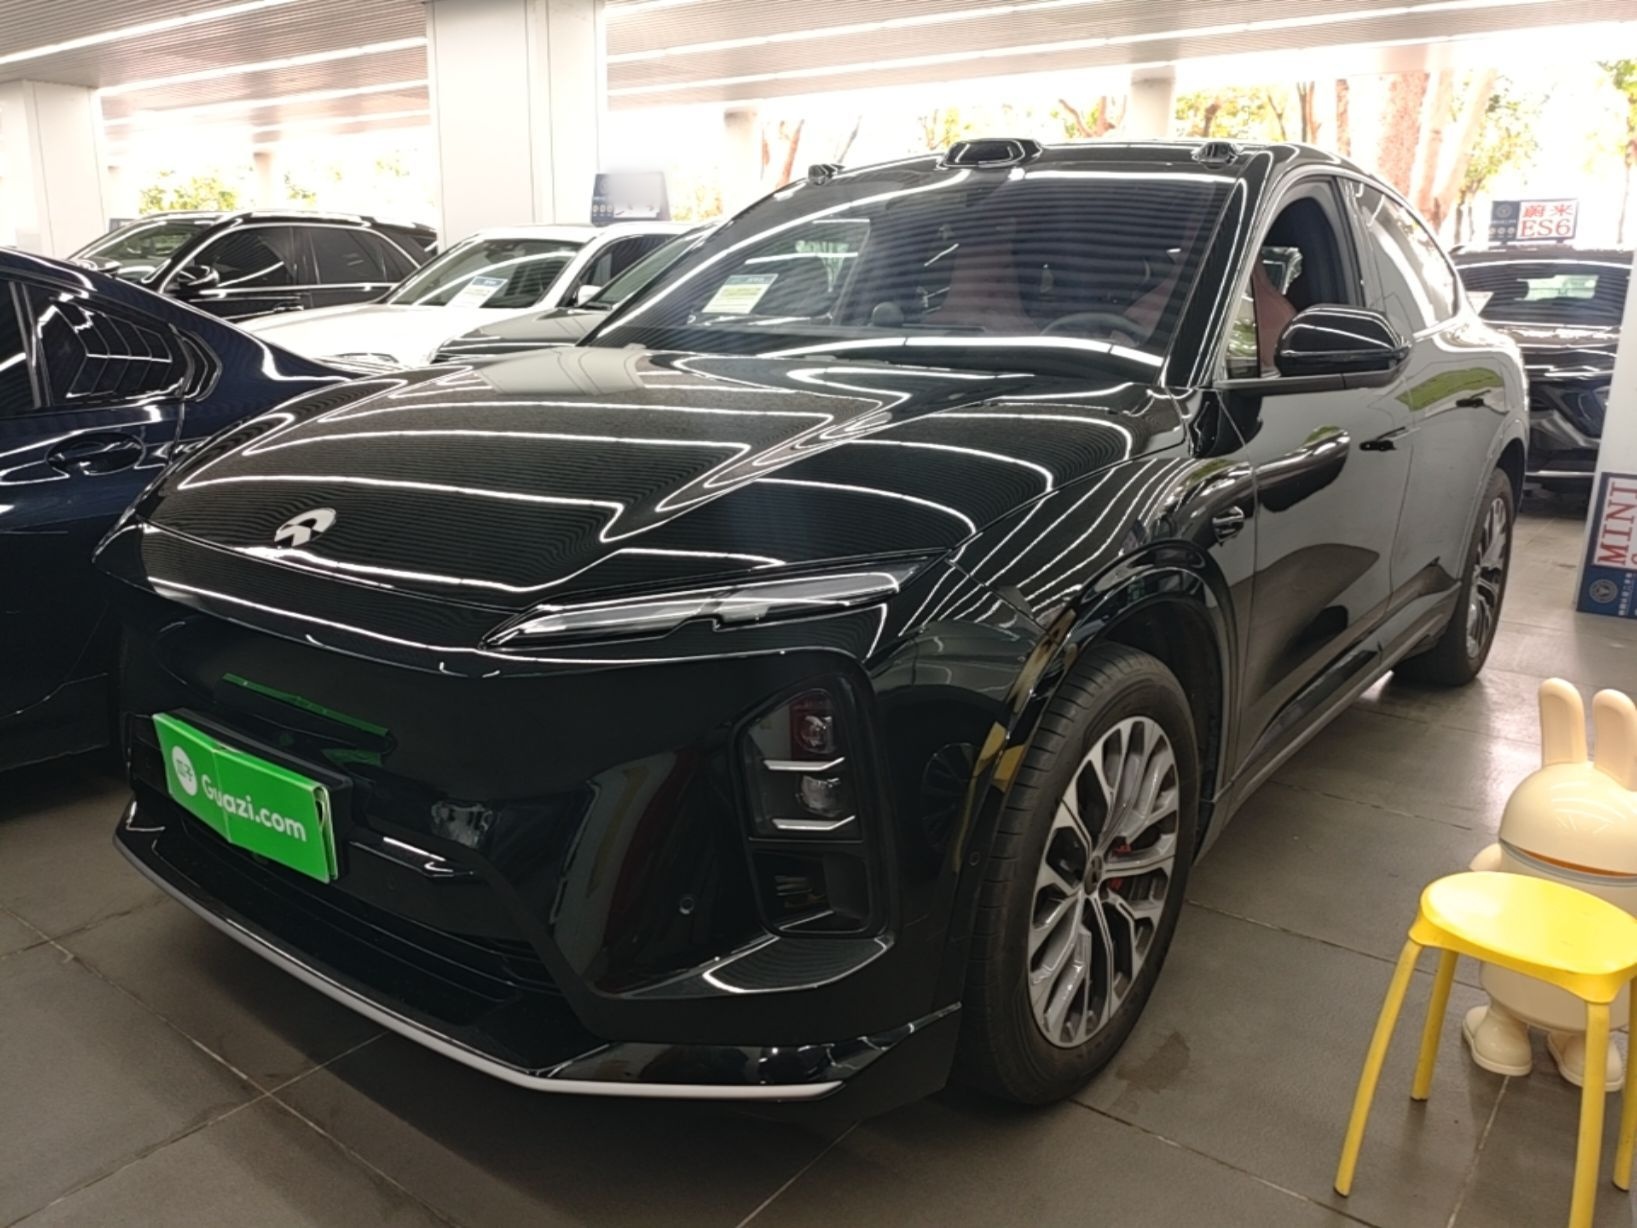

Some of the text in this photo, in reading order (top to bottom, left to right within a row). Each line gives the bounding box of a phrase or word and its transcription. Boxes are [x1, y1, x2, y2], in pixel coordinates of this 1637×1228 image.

[1520, 219, 1571, 237] ES6
[1598, 482, 1637, 565] MINI
[201, 774, 307, 842] Guazi.com
